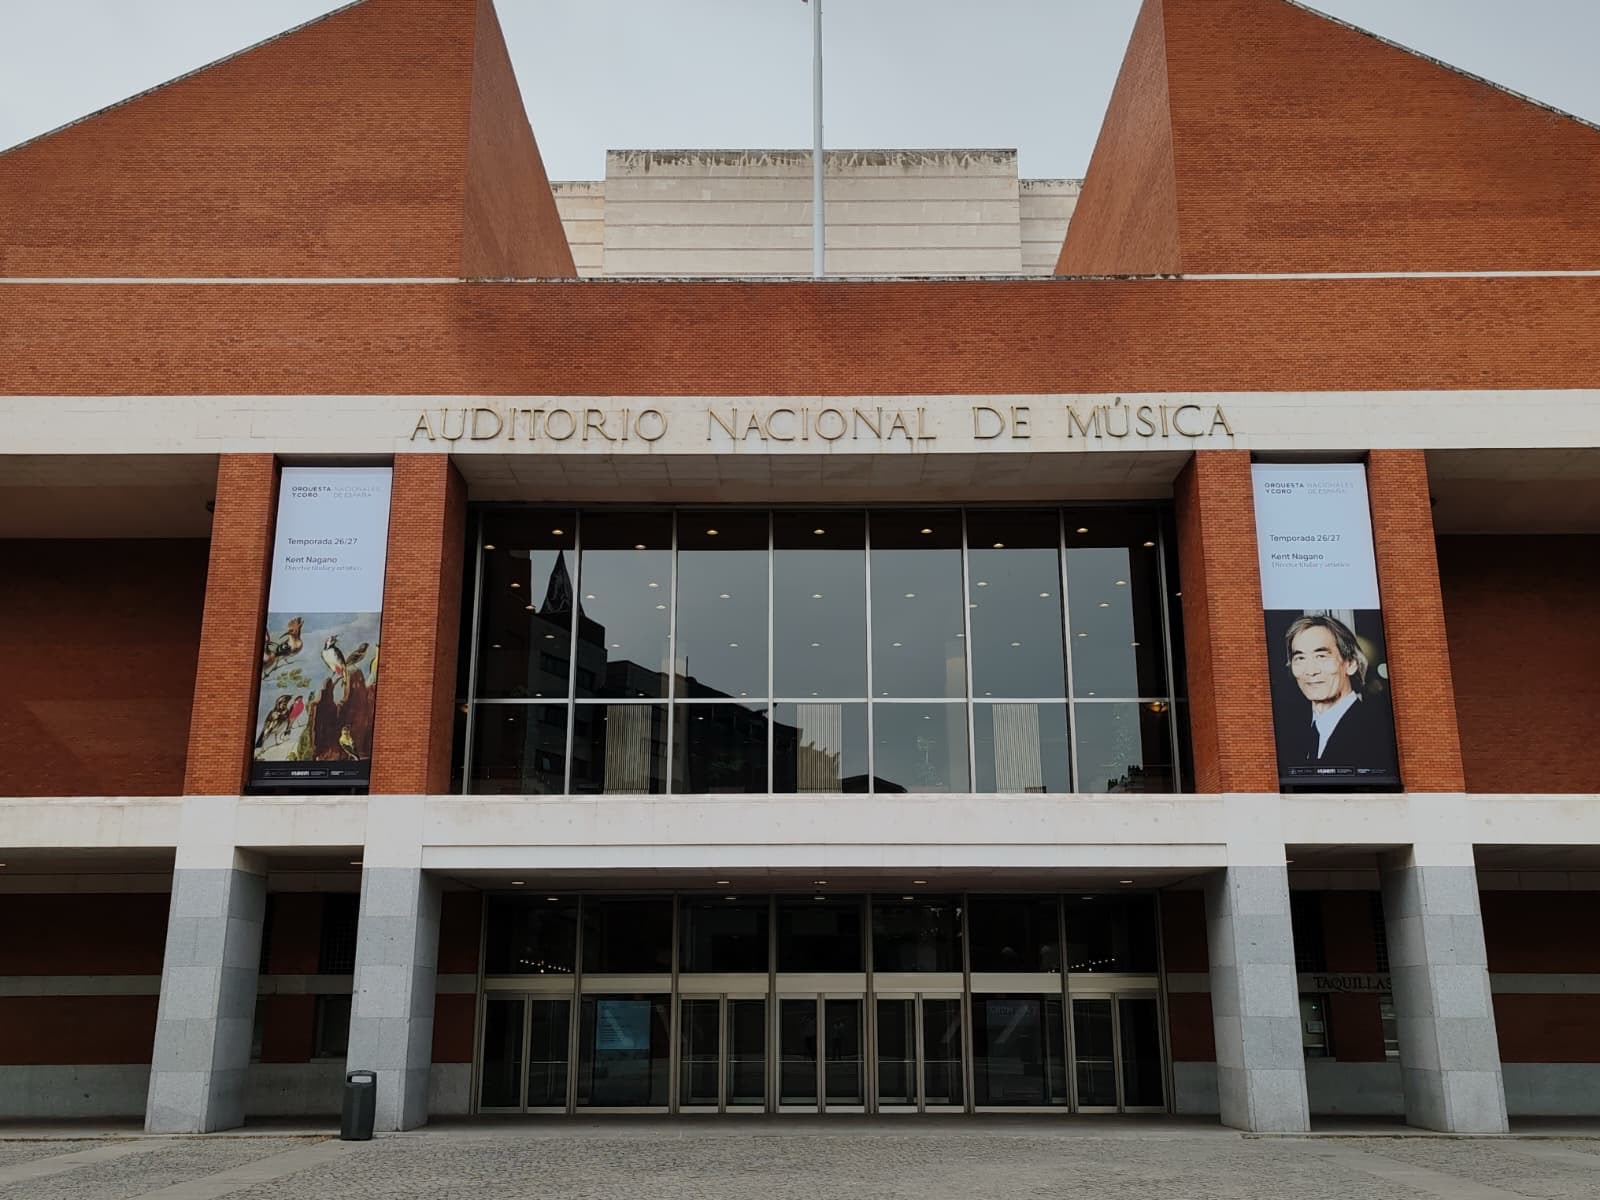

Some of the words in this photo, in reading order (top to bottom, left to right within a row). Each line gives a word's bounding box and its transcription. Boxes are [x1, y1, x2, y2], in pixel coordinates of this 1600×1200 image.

[410, 408, 669, 442] AUDITORIO
[706, 406, 936, 442] NACIONAL
[972, 405, 1031, 440] DE
[1066, 396, 1235, 439] MÚSICA
[288, 538, 332, 546] Temporada
[1270, 535, 1315, 543] Temporada
[306, 556, 338, 565] Nagano
[1292, 553, 1324, 561] Nagano
[1313, 976, 1392, 993] TAQUILLAS
